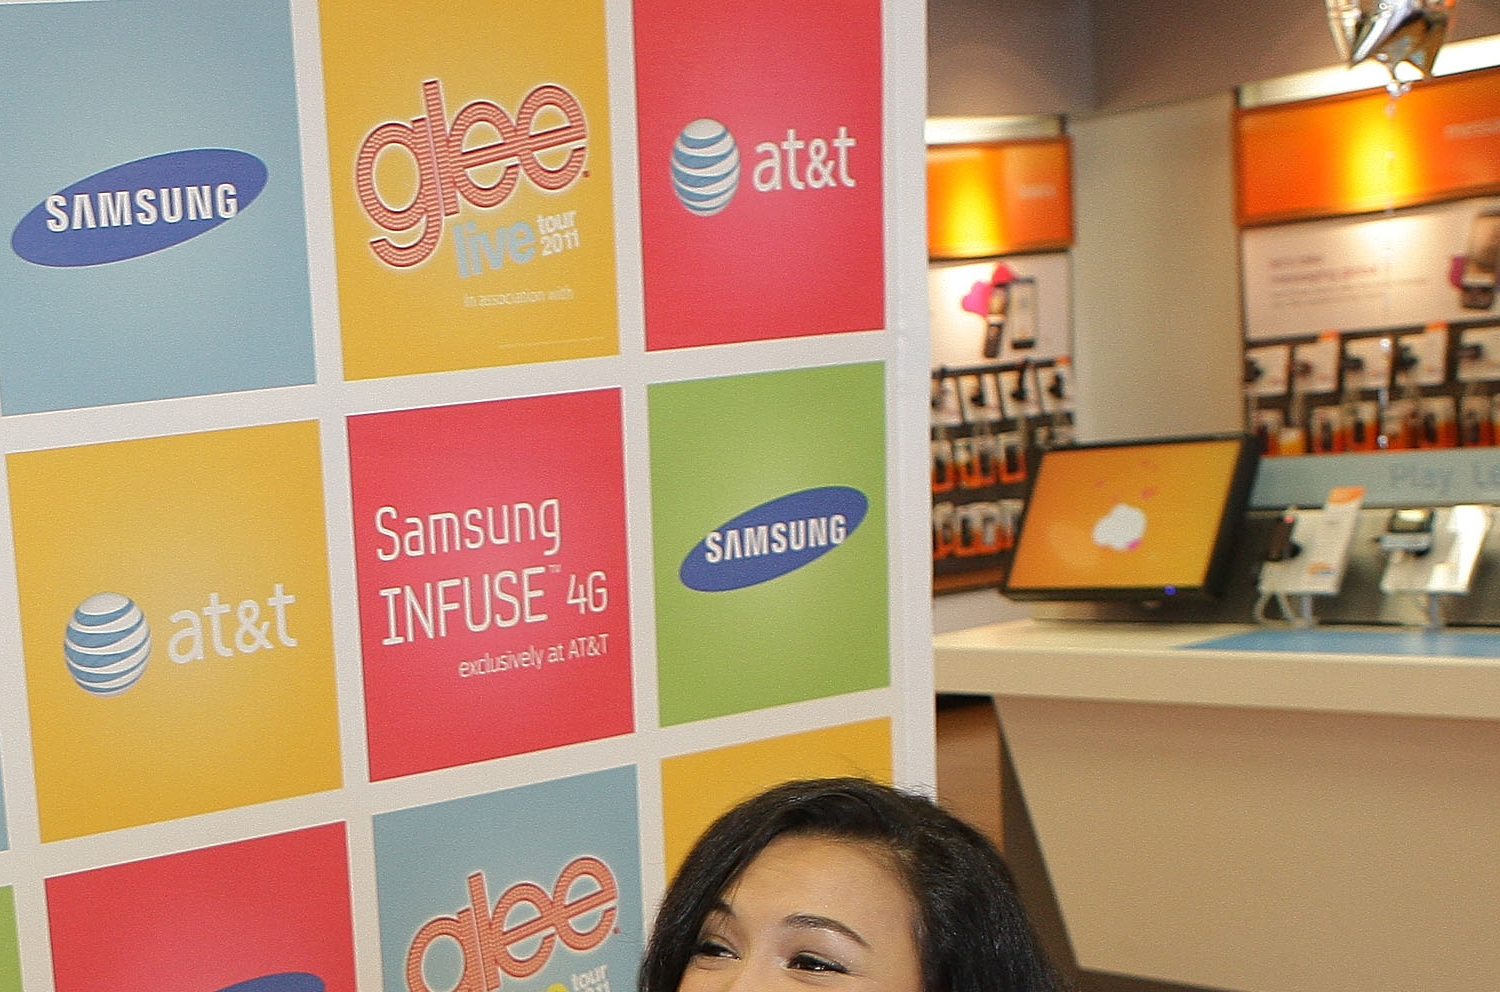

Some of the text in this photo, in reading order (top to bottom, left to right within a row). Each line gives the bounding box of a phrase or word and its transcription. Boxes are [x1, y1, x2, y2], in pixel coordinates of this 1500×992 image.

[355, 79, 587, 268] glee
[753, 126, 857, 192] at&t
[45, 182, 238, 232] SAMSUNG
[536, 210, 577, 235] tour
[452, 220, 537, 279] live
[540, 230, 580, 256] 2011
[375, 498, 560, 561] Samsung
[705, 513, 847, 563] SAMSUNG
[566, 571, 609, 615] 4G
[167, 583, 298, 664] at&t
[459, 633, 610, 678] exclusively at AT&T
[572, 964, 608, 992] tour
